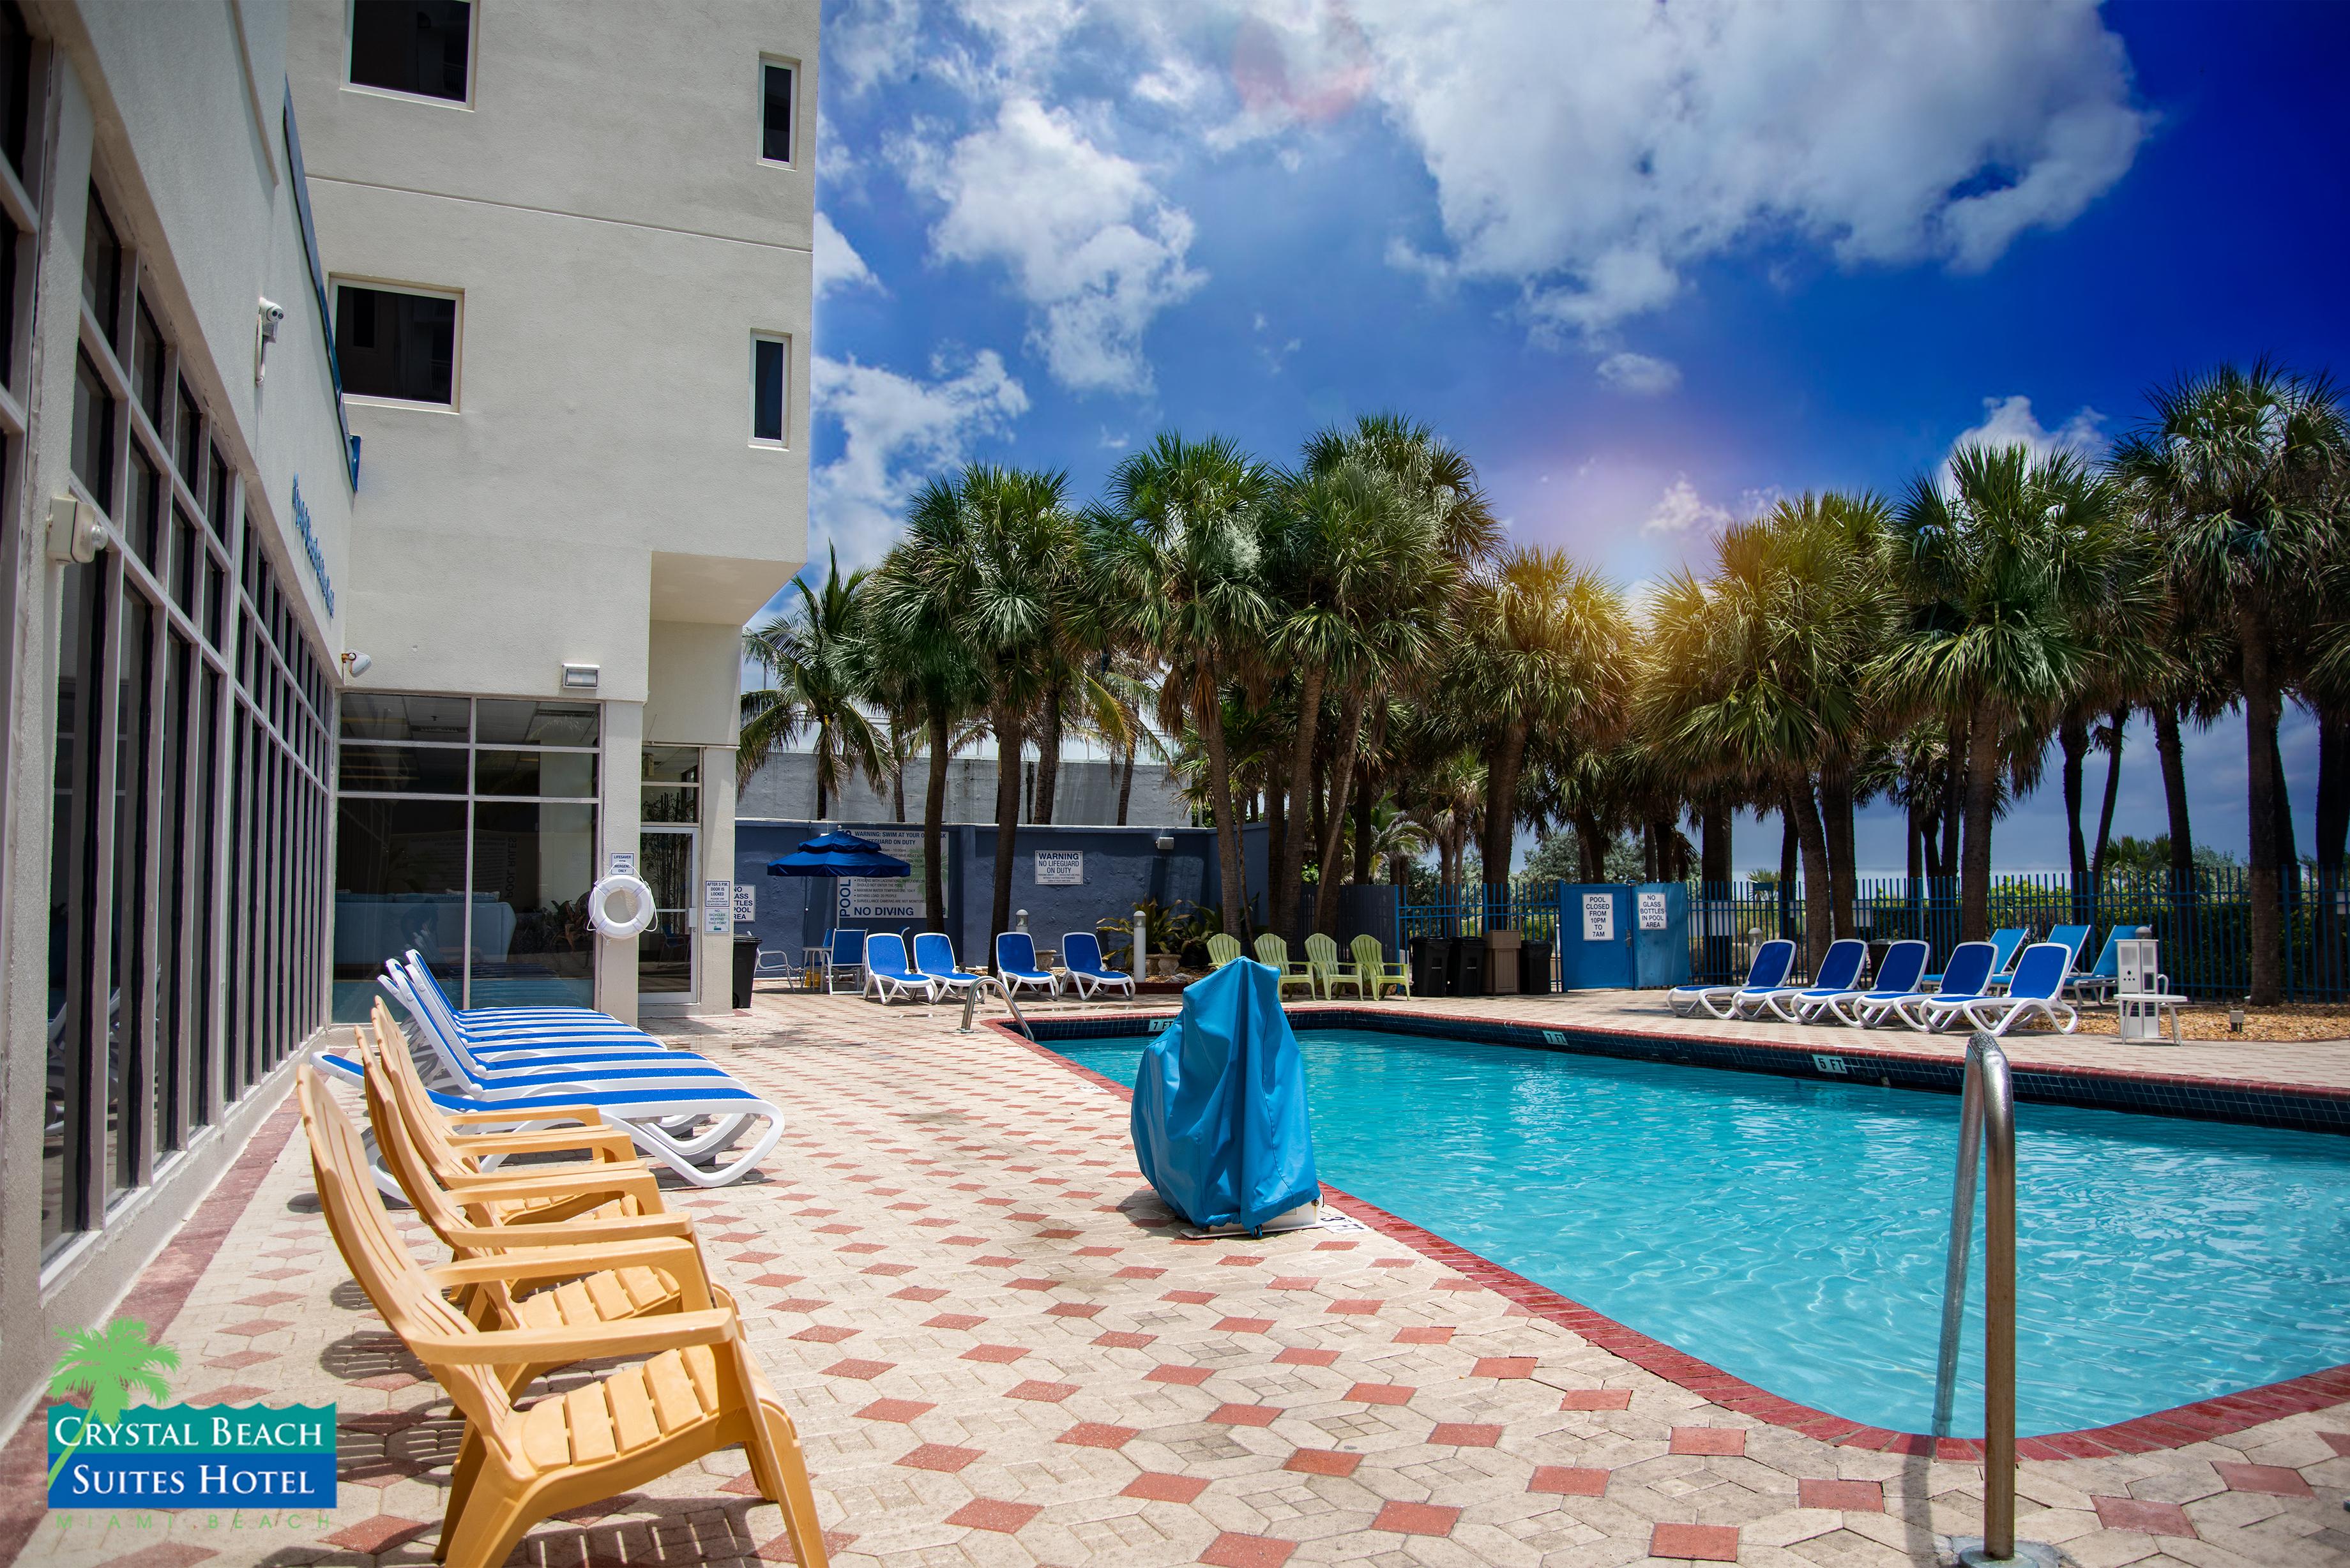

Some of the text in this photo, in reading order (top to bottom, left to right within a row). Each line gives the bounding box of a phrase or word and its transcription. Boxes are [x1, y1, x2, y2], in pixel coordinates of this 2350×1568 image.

[839, 878, 851, 917] POOL
[854, 907, 914, 916] NO DIVING
[1153, 1021, 1174, 1030] 7 FT
[1547, 1033, 1553, 1043] 7
[1817, 1057, 1827, 1069] 5
